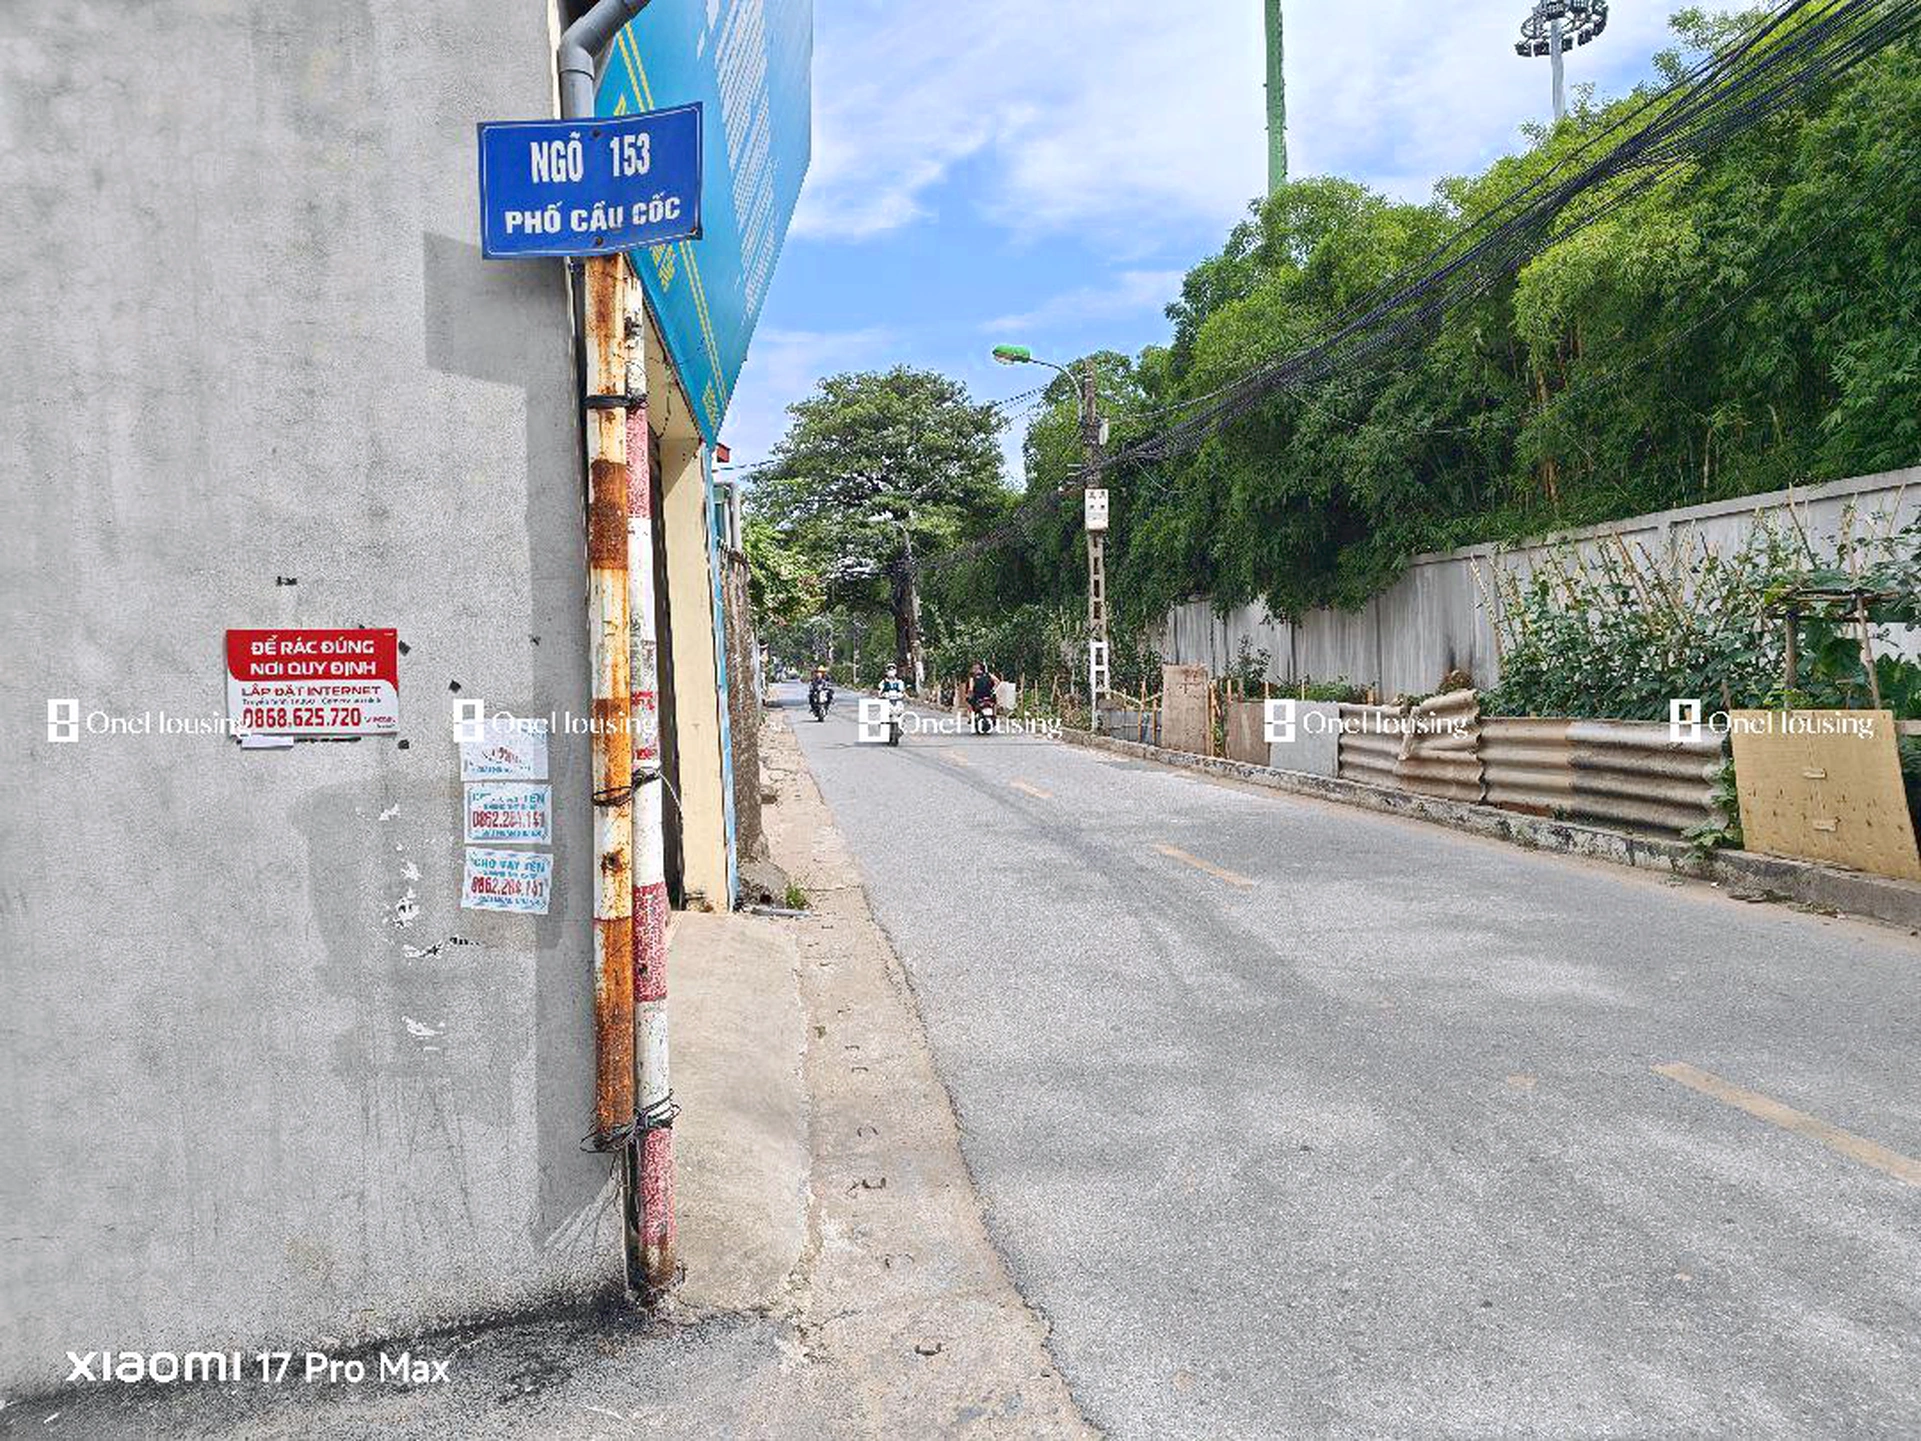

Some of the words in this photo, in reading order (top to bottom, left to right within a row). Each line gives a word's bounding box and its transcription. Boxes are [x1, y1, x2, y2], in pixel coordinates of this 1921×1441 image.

[530, 131, 584, 184] NGÕ
[610, 133, 651, 177] 153
[504, 201, 562, 234] PHỐ
[570, 200, 624, 232] CẦU
[632, 191, 681, 226] CỐC
[250, 634, 277, 655] ĐỂ
[281, 636, 318, 655] RÁC
[320, 636, 375, 654] ĐÚNG
[250, 661, 284, 676] NƠI
[287, 661, 328, 676] QUY
[330, 661, 376, 677] ĐỊNH
[307, 685, 382, 697] INTERNET
[242, 707, 362, 729] 0868.625.720
